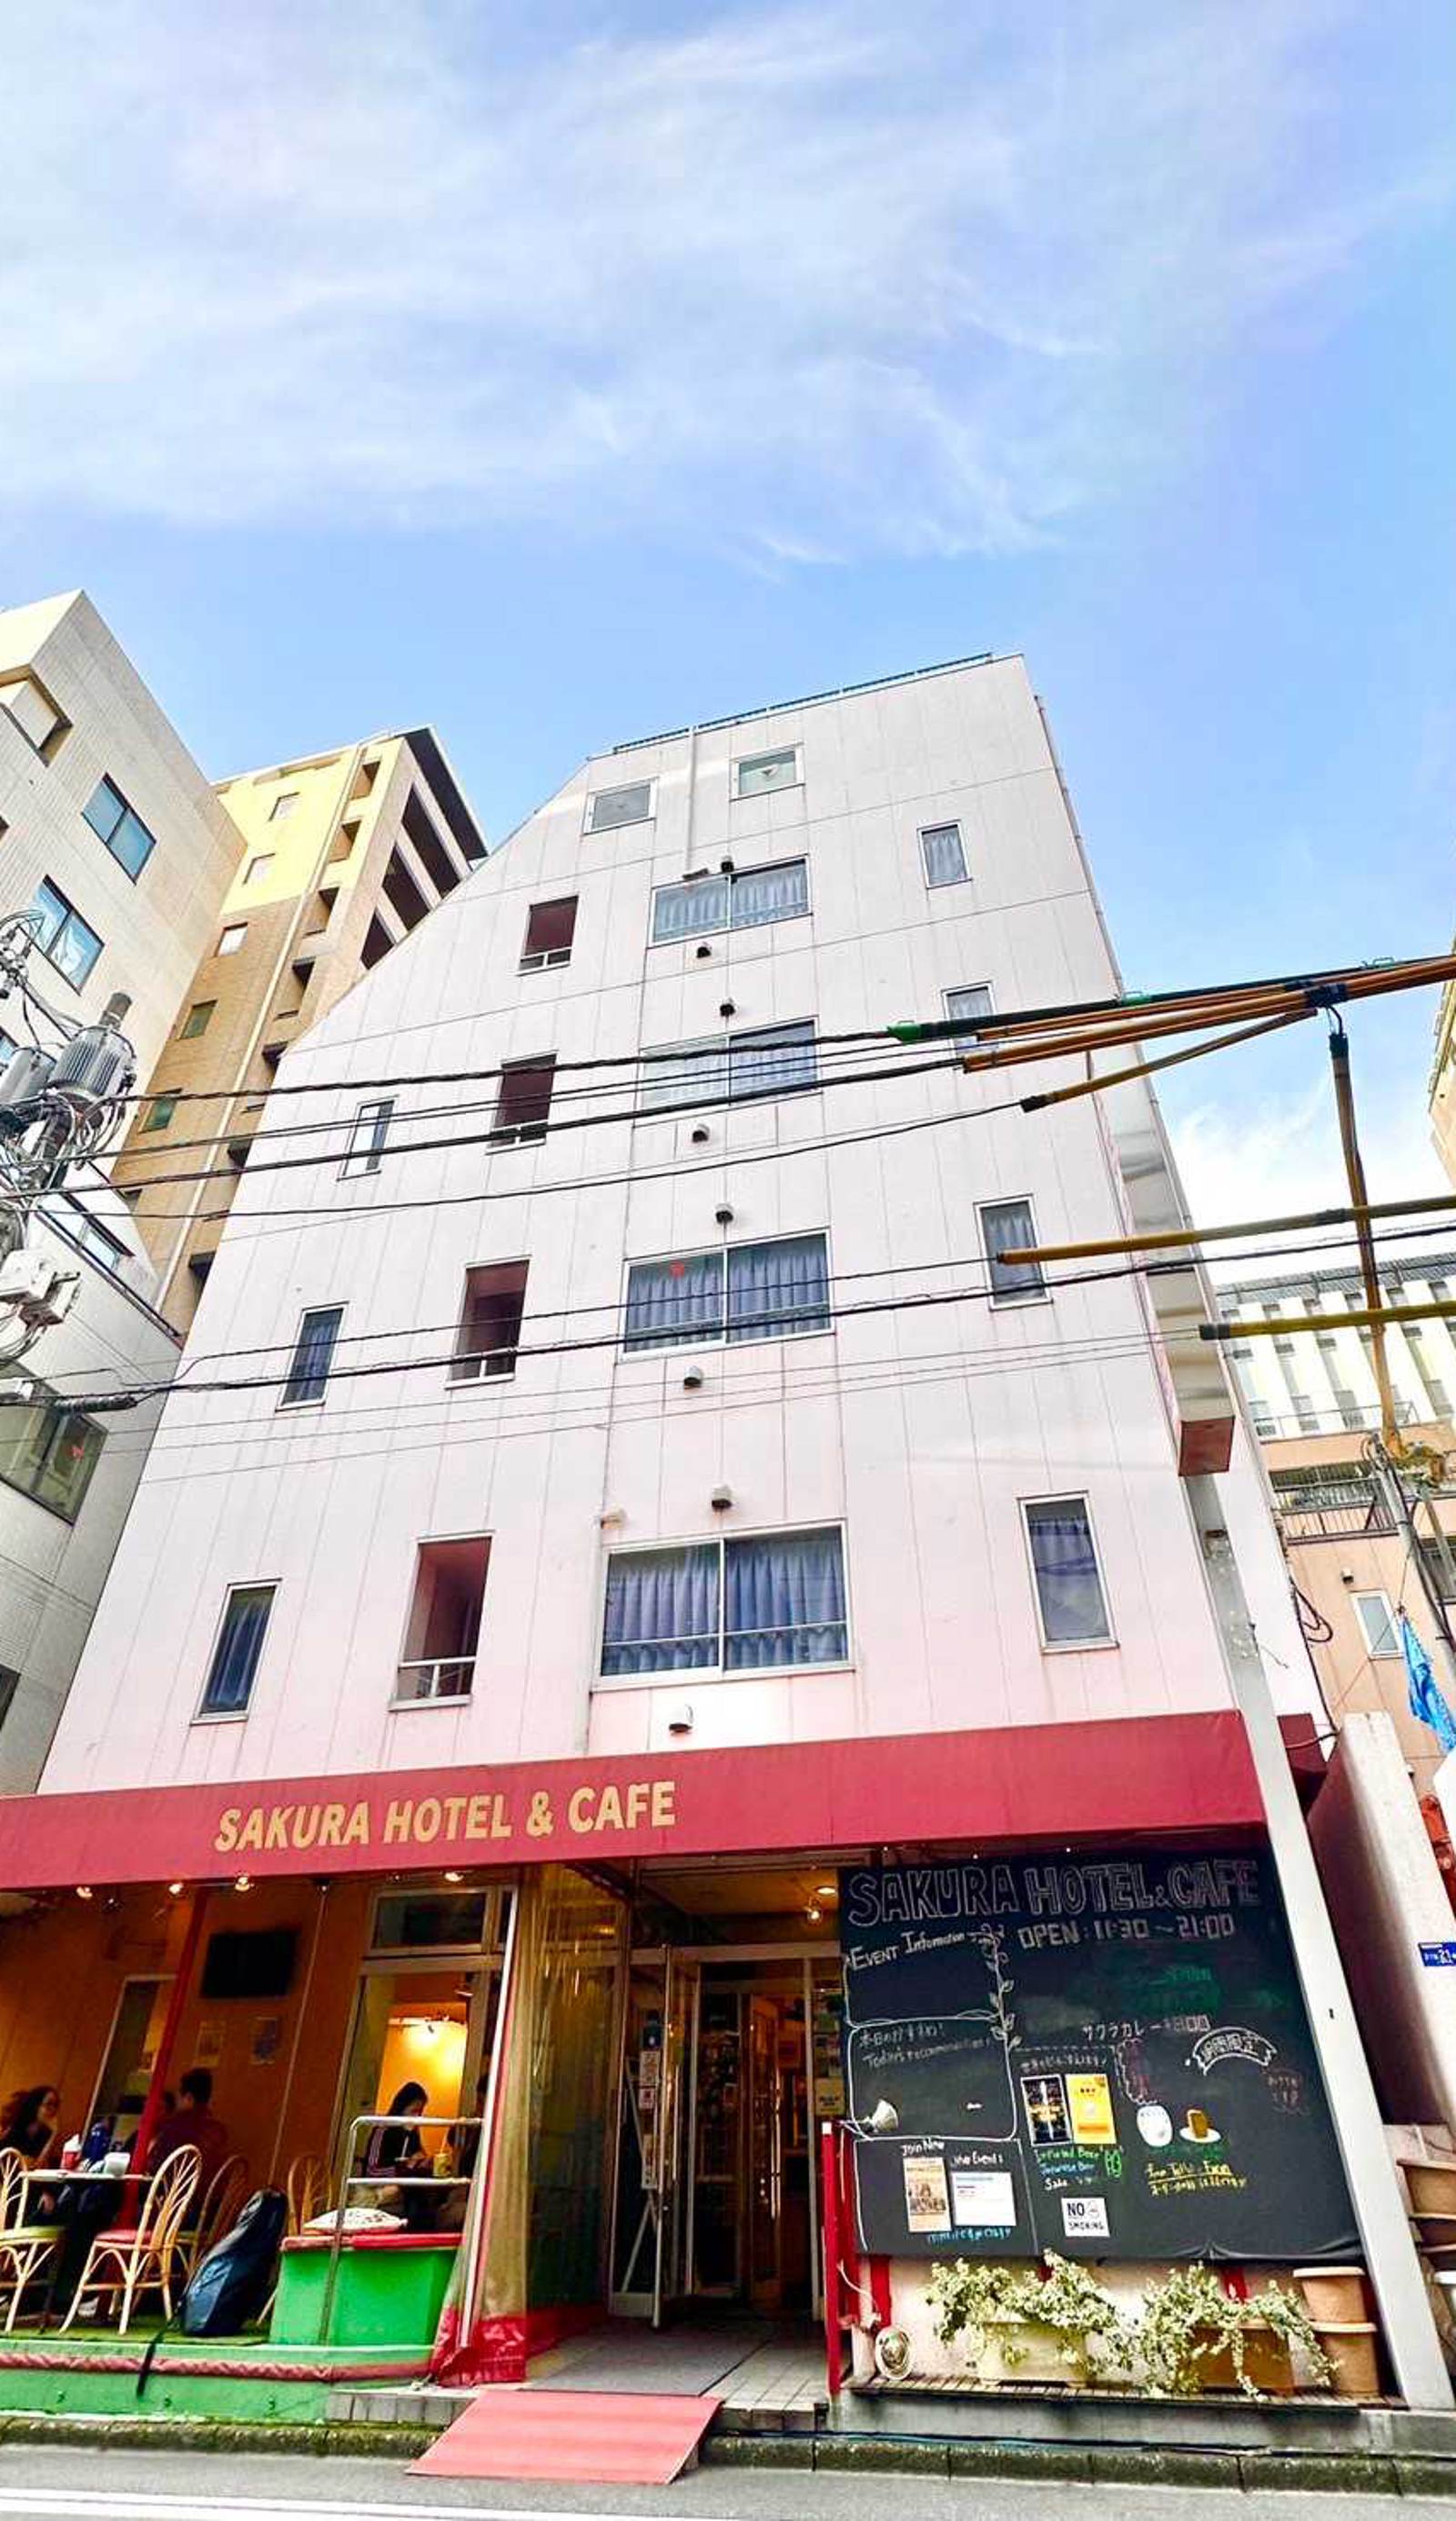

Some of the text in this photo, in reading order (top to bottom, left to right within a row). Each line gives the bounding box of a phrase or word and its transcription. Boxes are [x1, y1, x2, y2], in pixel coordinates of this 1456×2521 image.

[215, 1780, 675, 1852] SAKURA HOTEL & CAFE
[848, 1865, 1019, 1927] SAKURA
[1024, 1863, 1154, 1915] HOTEL
[1168, 1859, 1261, 1908] CAFE
[1094, 1919, 1149, 1940] 11:30
[1176, 1913, 1235, 1940] 21:00
[901, 1931, 966, 1954] Information
[1067, 2202, 1085, 2217] NO
